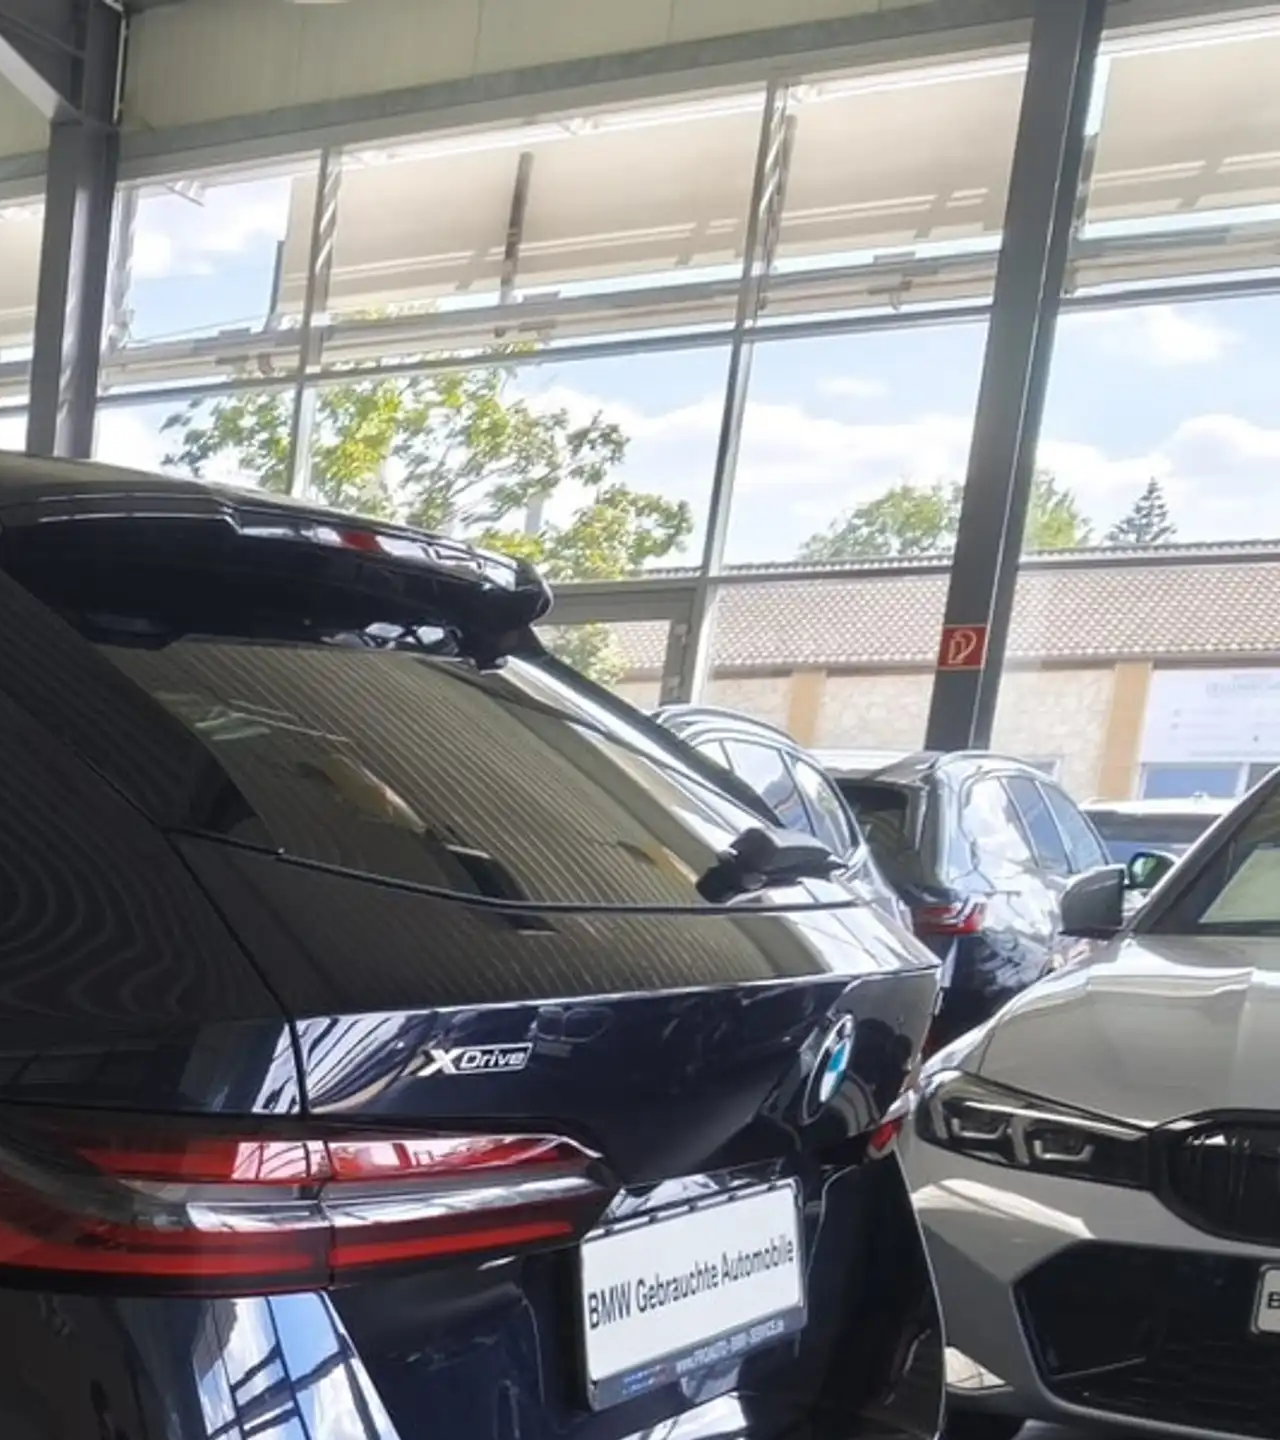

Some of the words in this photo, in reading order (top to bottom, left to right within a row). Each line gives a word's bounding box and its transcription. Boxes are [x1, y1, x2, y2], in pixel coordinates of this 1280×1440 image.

[587, 1280, 632, 1330] BMW
[635, 1260, 720, 1314] Gebrauchte
[721, 1233, 794, 1286] Automobile
